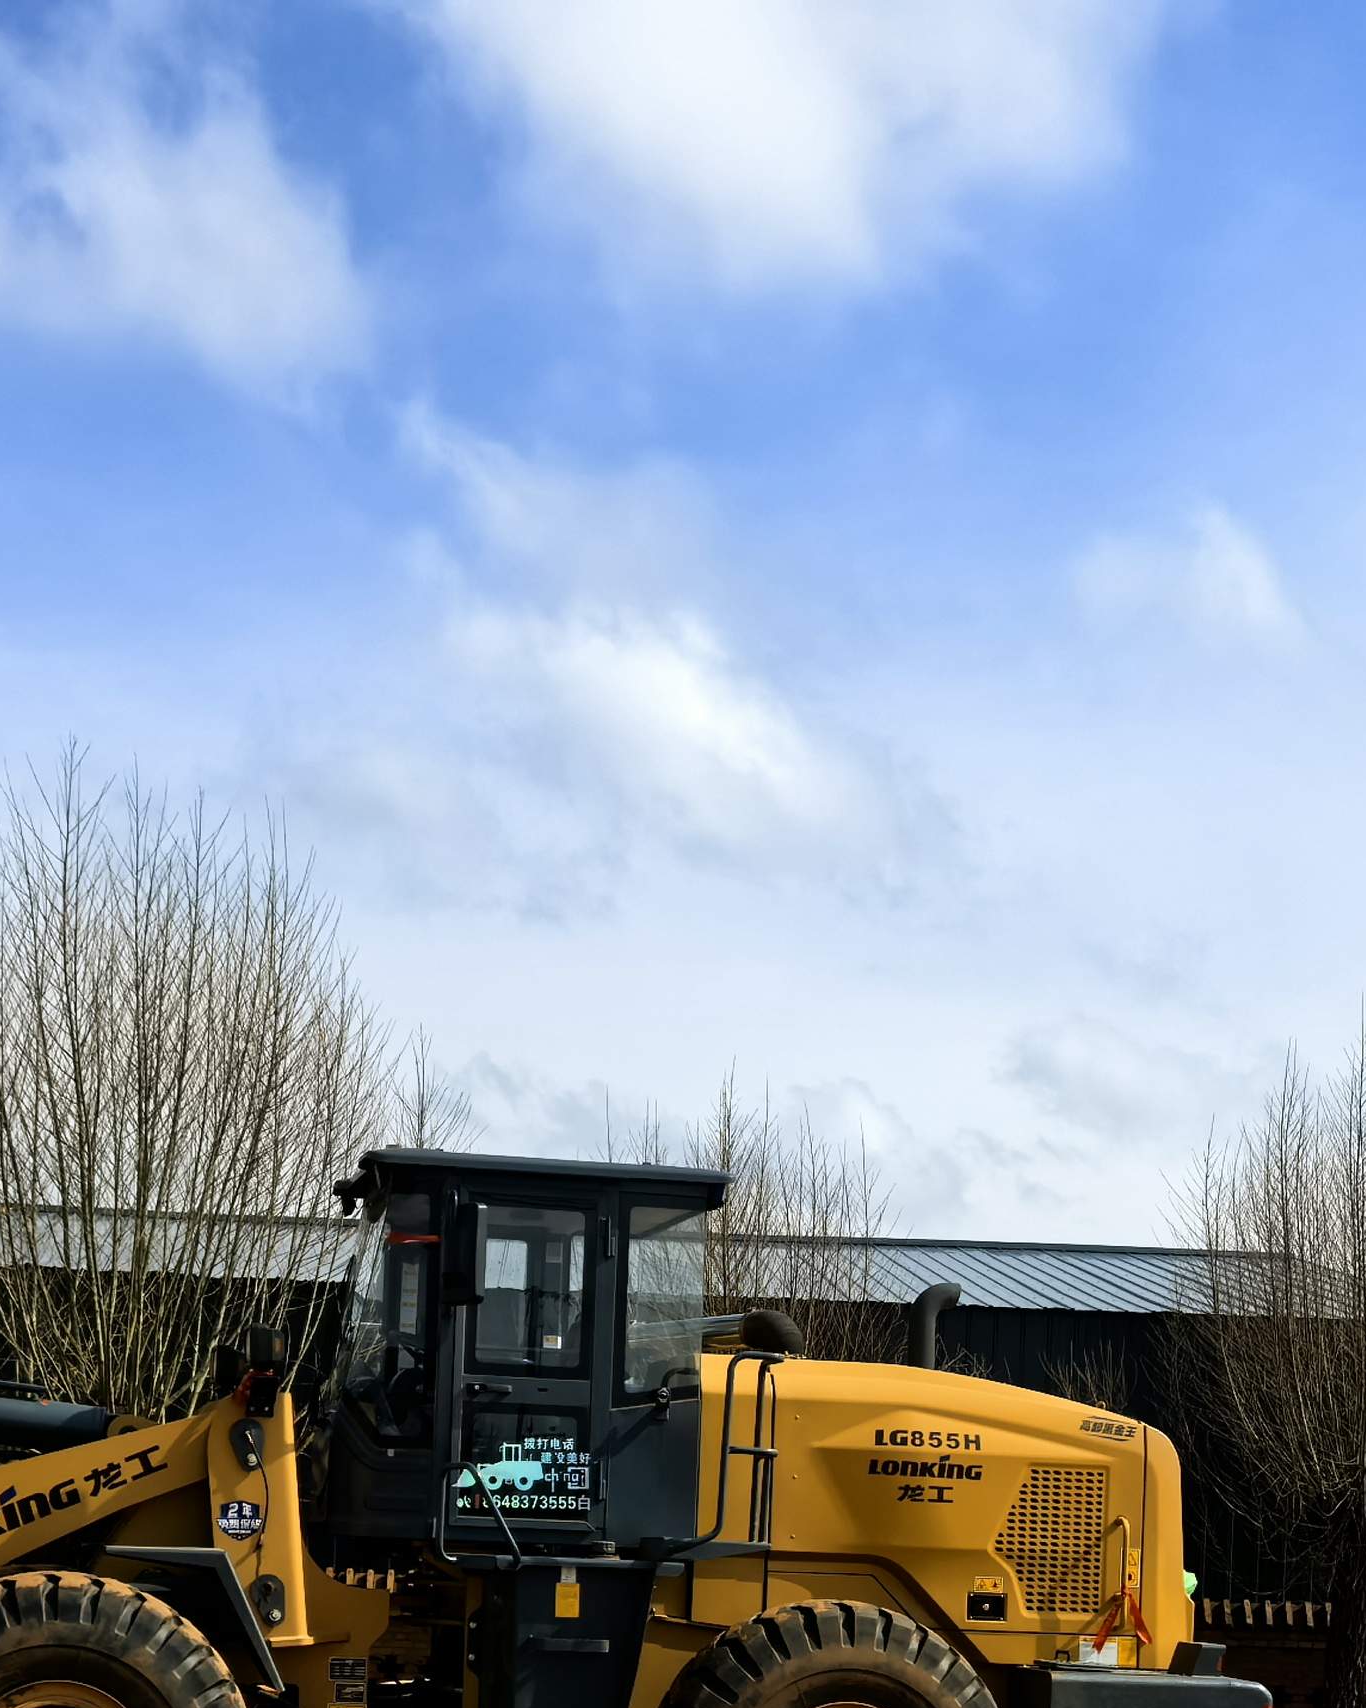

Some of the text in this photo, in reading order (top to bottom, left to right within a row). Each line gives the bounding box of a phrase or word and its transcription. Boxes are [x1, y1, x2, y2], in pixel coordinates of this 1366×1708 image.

[523, 1438, 575, 1450] 拨打电话
[874, 1429, 981, 1450] LG855H
[83, 1445, 169, 1497] 龙工
[896, 1484, 954, 1503] 龙工
